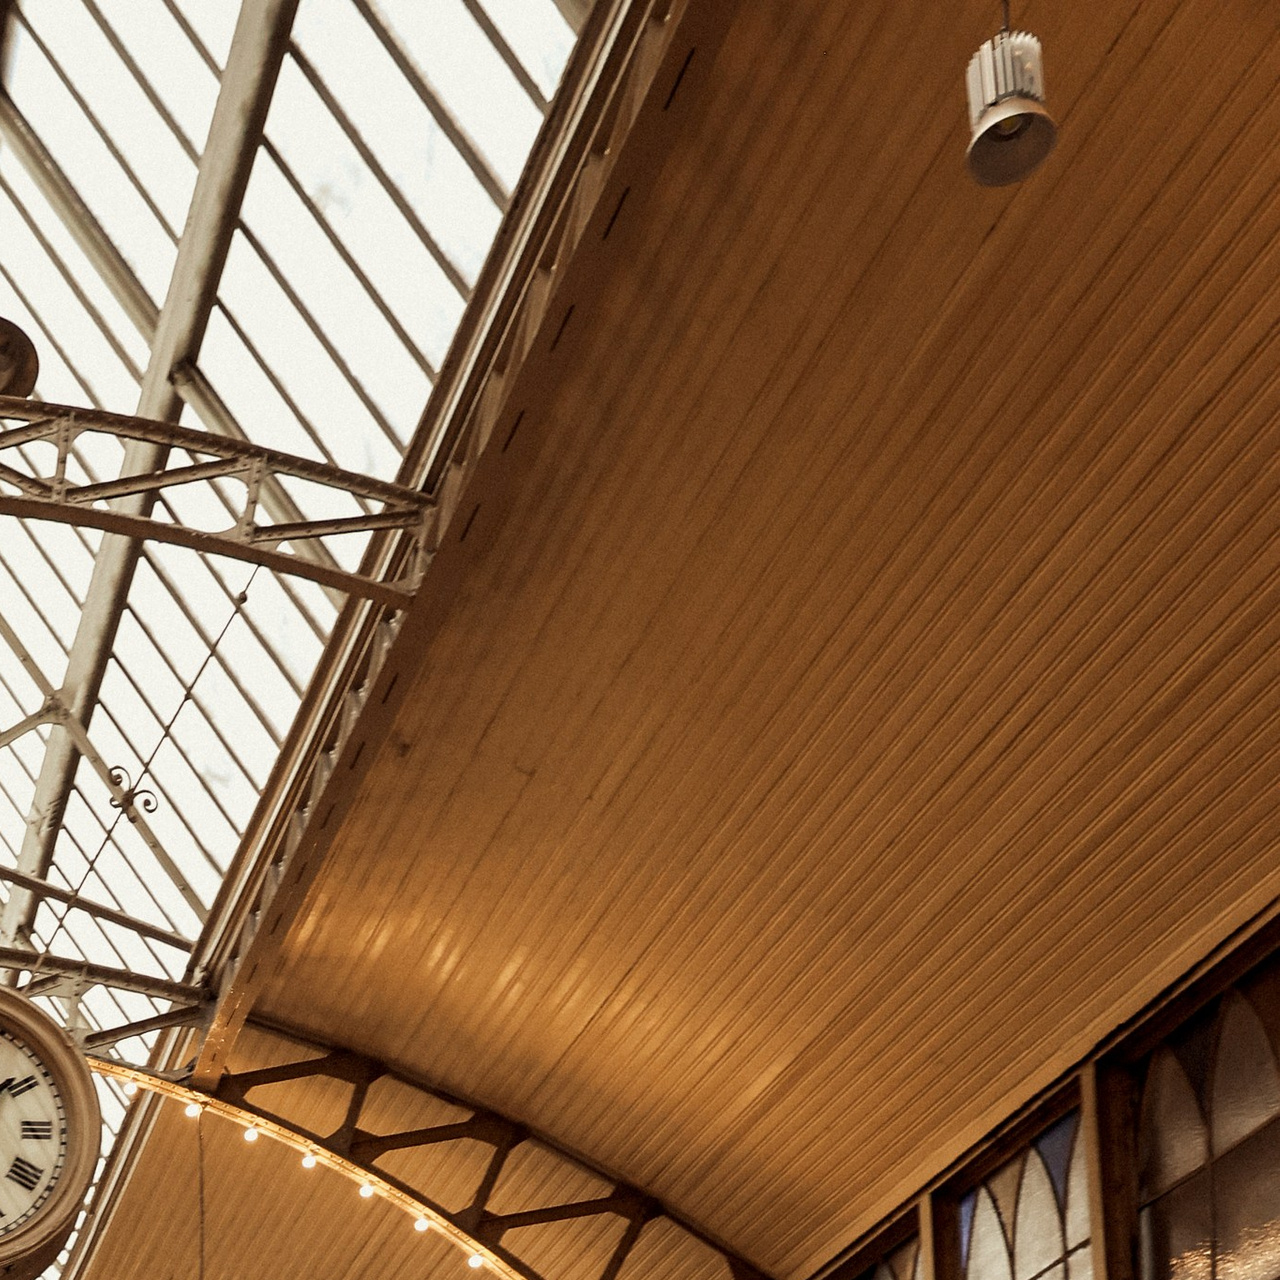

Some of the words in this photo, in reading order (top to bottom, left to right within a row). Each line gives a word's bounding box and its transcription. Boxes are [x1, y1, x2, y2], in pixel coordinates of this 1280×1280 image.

[8, 1075, 39, 1098] II
[21, 1121, 52, 1140] III
[6, 1157, 44, 1191] IIII
